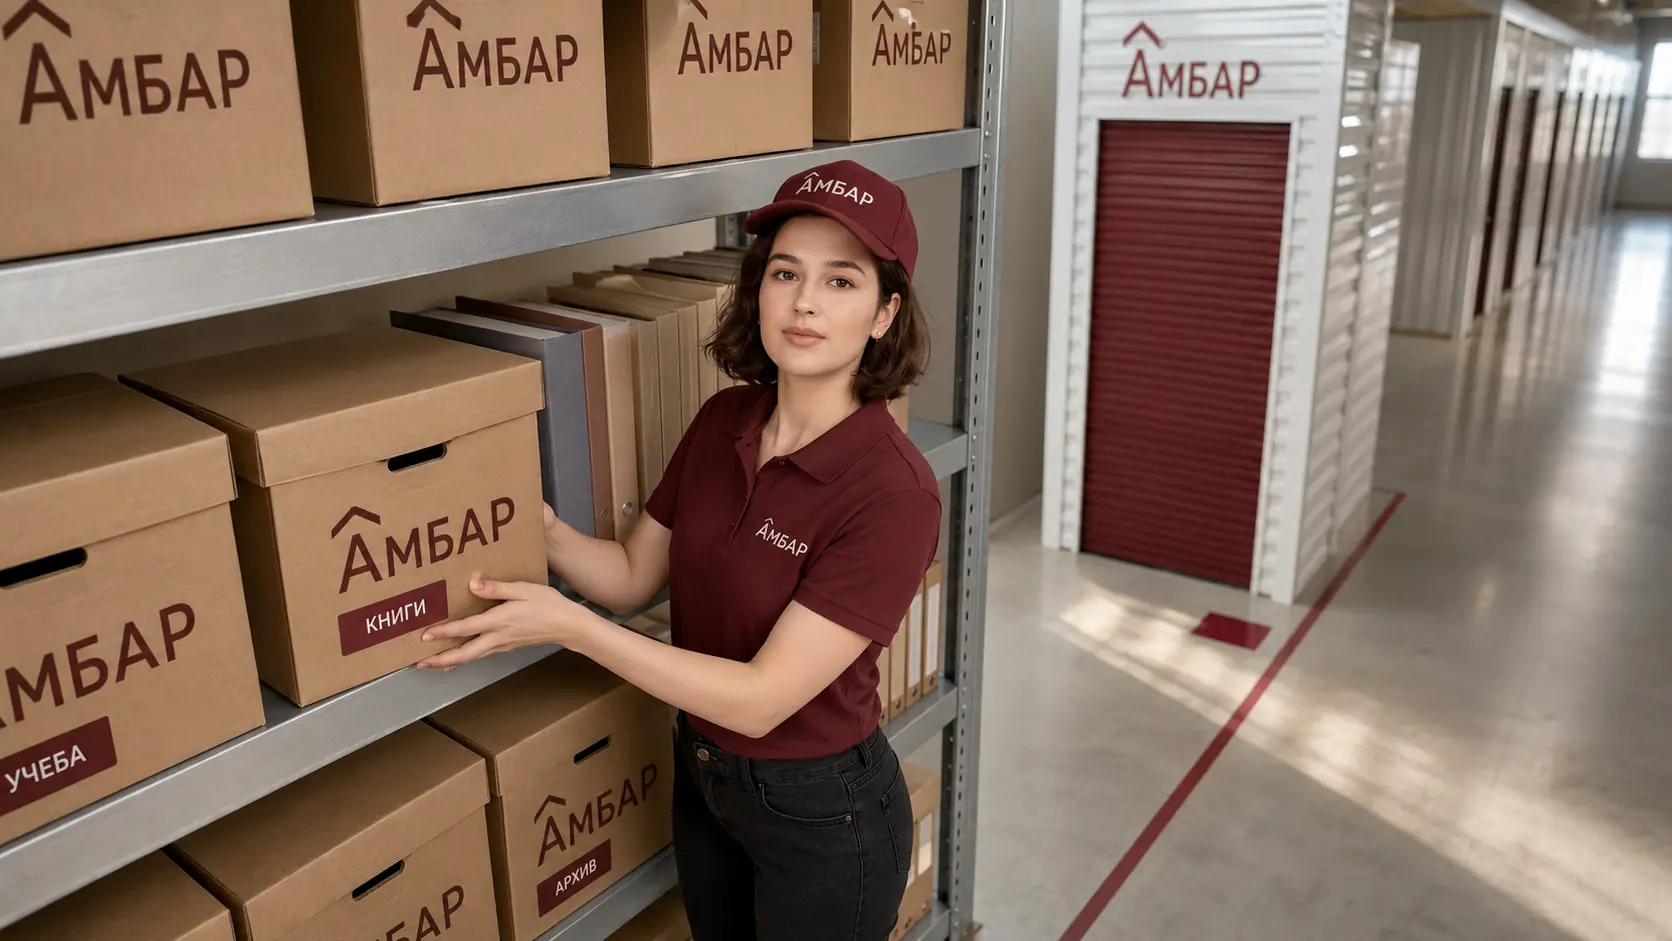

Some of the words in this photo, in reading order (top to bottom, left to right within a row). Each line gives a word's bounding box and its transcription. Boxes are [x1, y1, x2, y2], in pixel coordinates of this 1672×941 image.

[413, 28, 579, 91] АМБАР
[677, 21, 793, 75] АМБАР
[872, 23, 952, 66] АМБАР
[19, 43, 250, 125] АМБАР
[1121, 49, 1262, 99] АМБАР
[795, 177, 874, 206] АМБАР
[338, 496, 516, 594] АМБАР
[755, 522, 808, 557] АМБАР
[365, 598, 427, 634] КНИГИ
[0, 602, 196, 730] МБАР
[4, 744, 87, 794] УЧЕБА
[537, 763, 659, 868] АМБАР
[555, 858, 597, 896] АРХИВ
